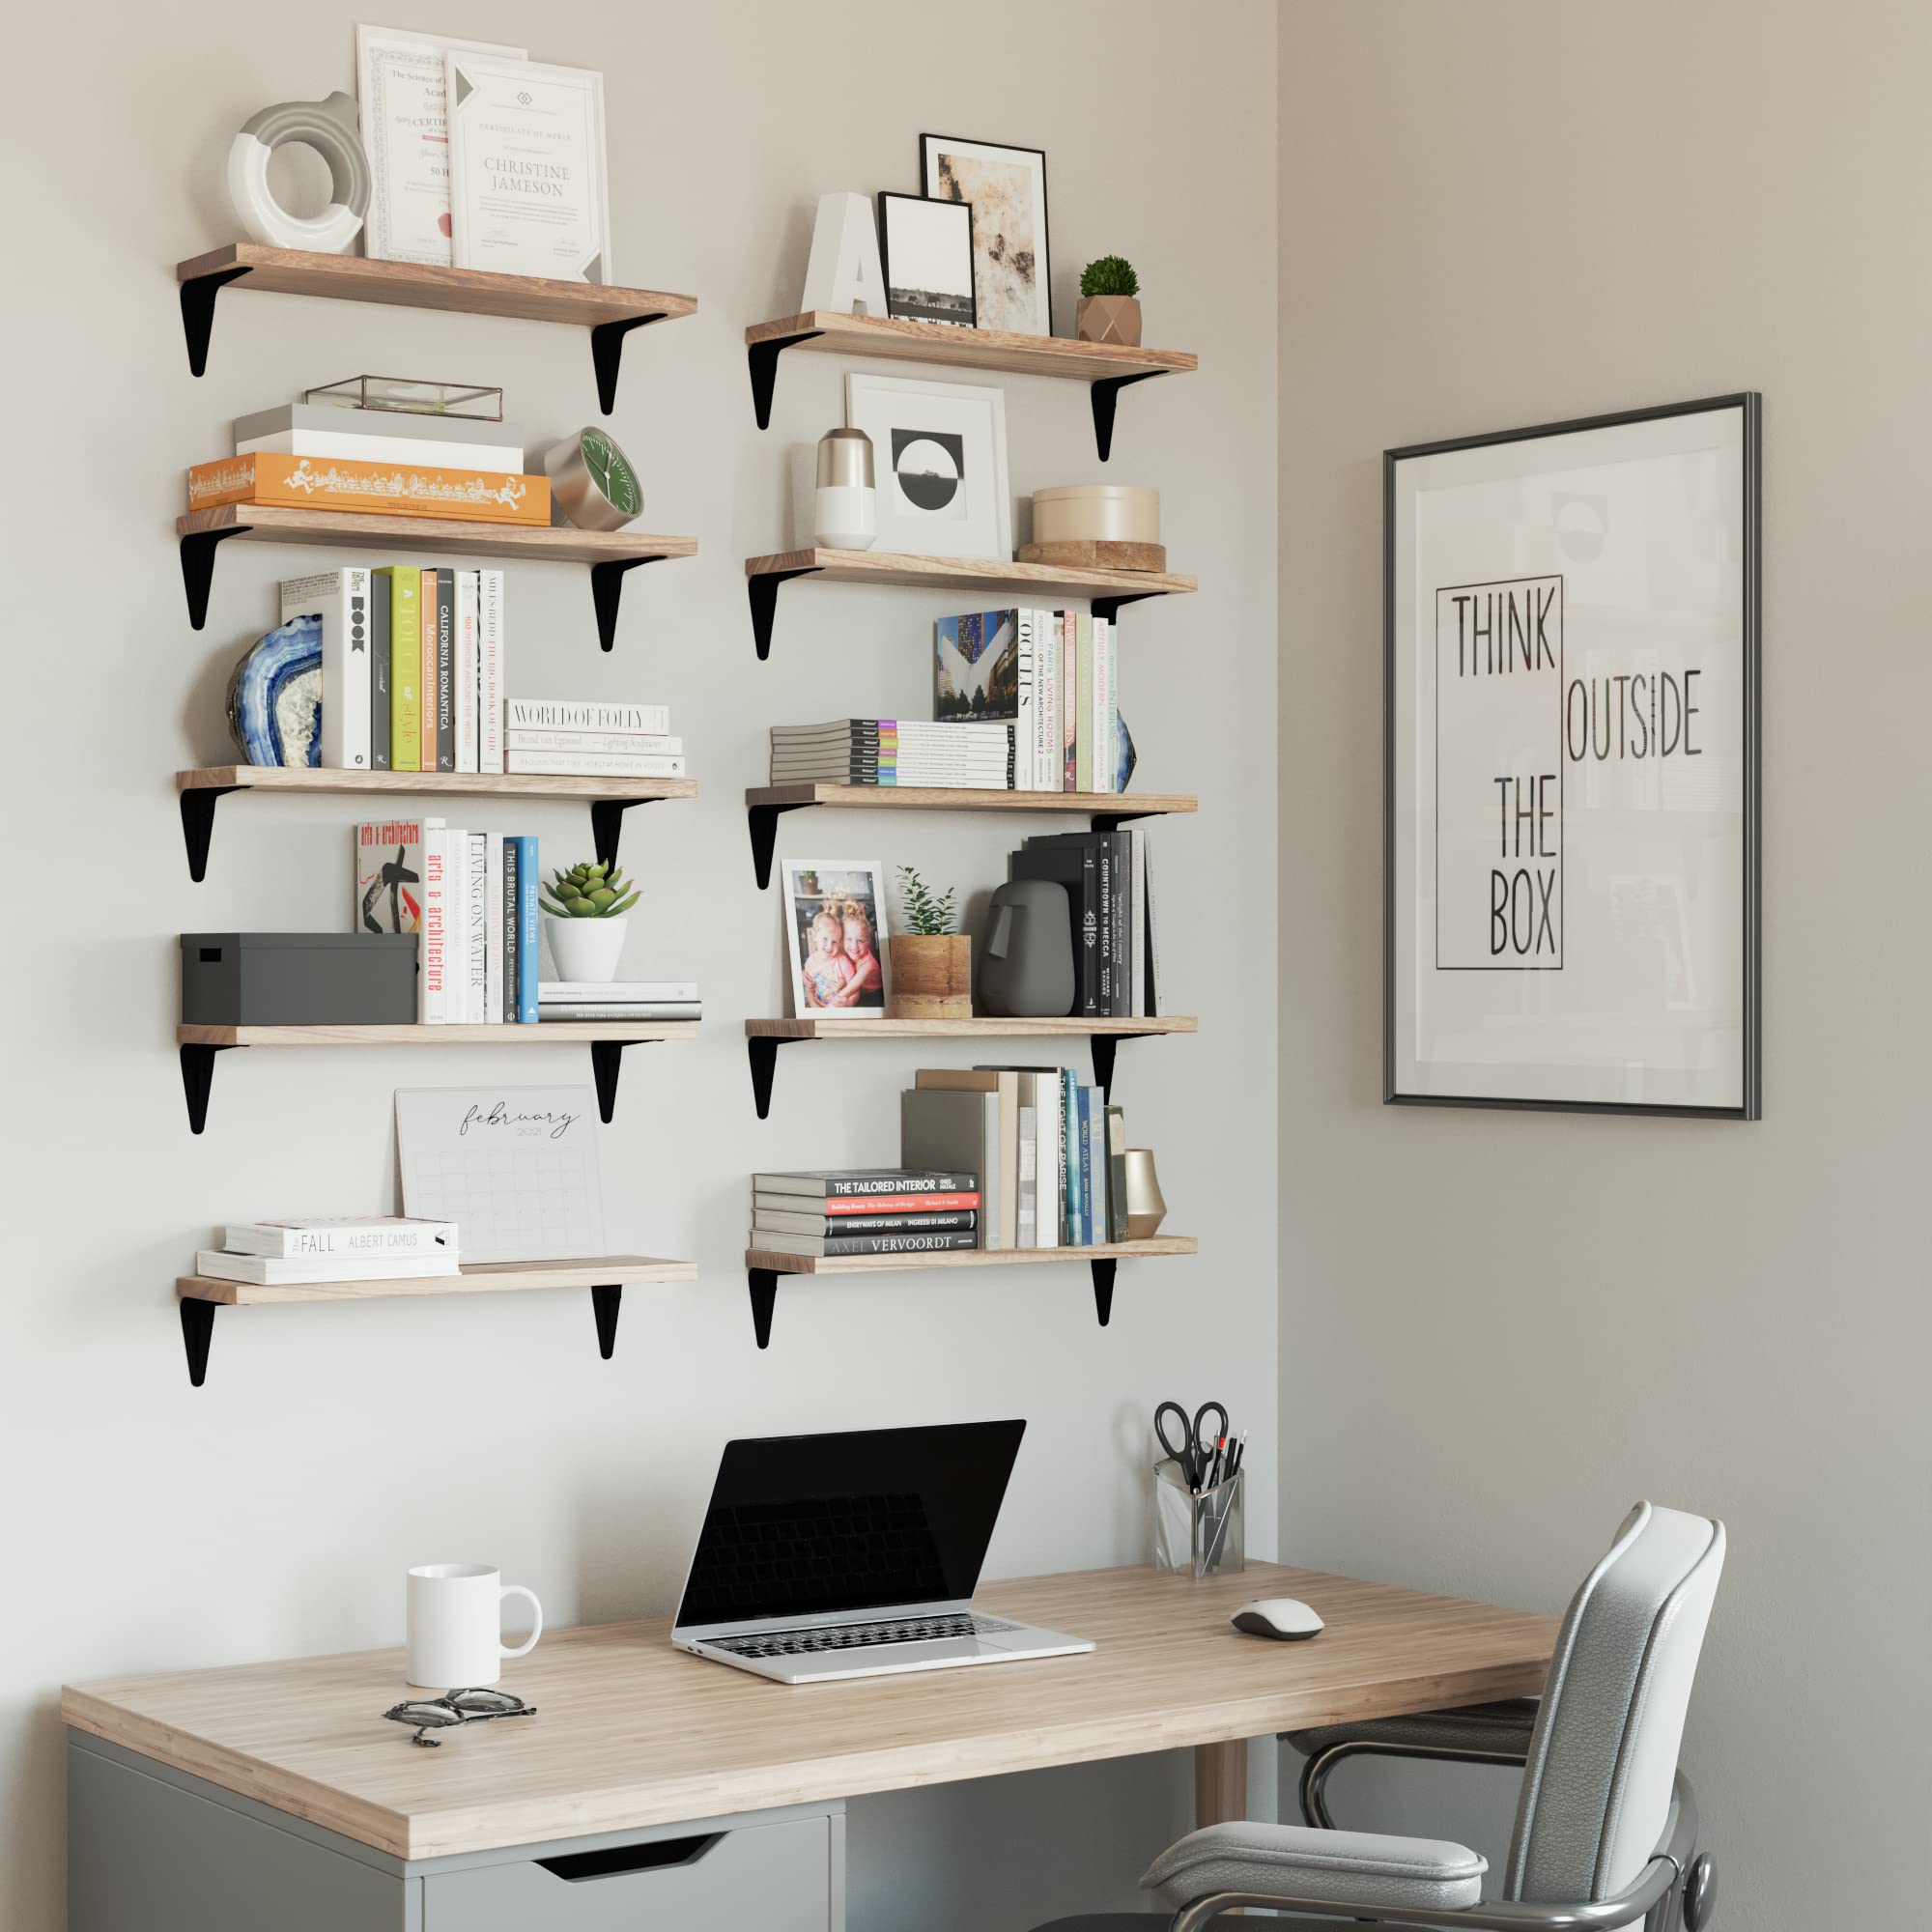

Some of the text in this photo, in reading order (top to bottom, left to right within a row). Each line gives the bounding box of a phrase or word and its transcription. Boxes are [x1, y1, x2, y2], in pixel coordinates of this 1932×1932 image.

[484, 156, 571, 181] CHRISTINE
[491, 175, 563, 197] JAMESON
[351, 596, 365, 654] BOOK
[1065, 617, 1074, 643] NEW
[1451, 585, 1556, 678] THINK
[440, 605, 449, 731] CALIFORNIA ROMANTICA
[1019, 623, 1032, 707] OCULUS
[1037, 654, 1044, 663] OF
[515, 705, 641, 728] WORLD OF FOLLY
[1567, 669, 1703, 762] OUTSIDE
[1493, 774, 1557, 859] THE
[361, 821, 373, 846] arts
[428, 855, 444, 882] arts
[506, 849, 516, 873] THIS
[506, 875, 516, 914] BRUTAL
[470, 841, 483, 989] LIVING ON WATER
[1491, 867, 1556, 956] BOX
[506, 917, 516, 953] WORLD
[428, 907, 444, 991] architecture
[459, 1101, 581, 1139] february
[517, 1126, 542, 1137] 2021
[1059, 1135, 1066, 1151] OF
[835, 1179, 936, 1194] THE TAILORED INTERIOR
[300, 1234, 334, 1253] FALL
[348, 1236, 384, 1250] ALBERT
[387, 1233, 418, 1247] CAMUS
[831, 1240, 867, 1253] AXEL
[871, 1236, 952, 1252] VERVOORDT
